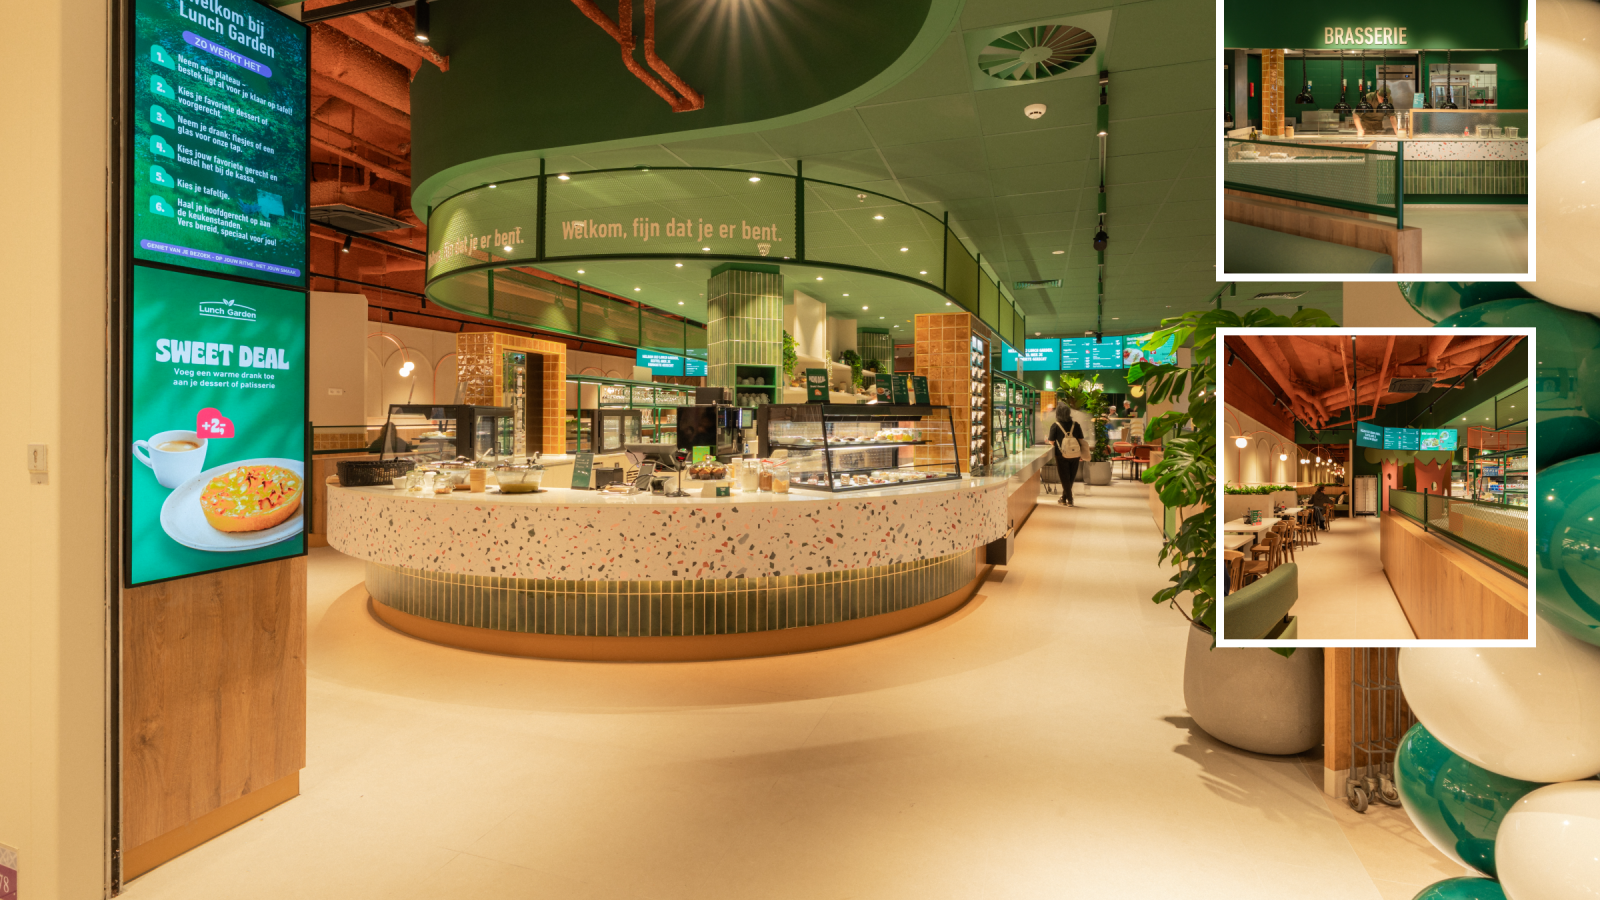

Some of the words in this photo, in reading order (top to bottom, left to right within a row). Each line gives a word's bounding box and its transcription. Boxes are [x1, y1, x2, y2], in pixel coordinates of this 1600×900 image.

[180, 0, 224, 34] Lunch
[228, 24, 274, 58] Garden
[190, 0, 244, 26] elkom
[248, 16, 264, 40] bij
[1324, 26, 1408, 45] BRASSERIE
[156, 52, 164, 63] 1.
[194, 36, 208, 48] ZO
[210, 44, 242, 64] WERKT
[244, 59, 262, 72] HET
[178, 54, 199, 70] Neem
[200, 64, 214, 76] een
[215, 70, 240, 86] plateau
[156, 82, 166, 94] 2.
[178, 64, 202, 80] bestek
[204, 74, 216, 87] ligt
[218, 80, 224, 90] al
[226, 84, 241, 95] voor
[242, 89, 248, 98] je
[250, 92, 266, 106] klaar
[268, 100, 276, 110] op
[156, 112, 165, 123] 3.
[178, 86, 194, 99] Kies
[196, 92, 202, 102] je
[204, 95, 234, 114] favoriete
[236, 108, 260, 124] dessert
[262, 118, 268, 126] of
[178, 97, 222, 118] voorgerecht.
[178, 114, 199, 130] Neem
[200, 122, 207, 132] je
[208, 126, 230, 140] drank:
[232, 134, 254, 148] flesjes
[256, 142, 262, 150] of
[263, 146, 274, 154] een
[178, 126, 194, 136] glas
[195, 131, 210, 142] voor
[212, 137, 228, 148] onze
[230, 142, 242, 154] tap.
[156, 142, 166, 153] 4.
[178, 144, 194, 156] Kies
[194, 148, 212, 162] jouw
[214, 155, 244, 172] favoriete
[244, 166, 268, 179] gerecht
[270, 174, 278, 182] en
[178, 154, 200, 168] bestel
[202, 161, 213, 172] het
[215, 165, 224, 176] bij
[226, 168, 234, 178] de
[236, 172, 256, 184] kassa.
[156, 172, 165, 182] 5.
[178, 178, 192, 190] Kies
[194, 184, 202, 194] je
[204, 186, 230, 200] tafeltje.
[156, 202, 165, 212] 6.
[178, 198, 194, 210] Haal
[195, 203, 202, 212] je
[204, 204, 248, 224] hoofdgerecht
[250, 218, 258, 226] op
[260, 220, 270, 228] aan
[178, 208, 186, 217] de
[188, 210, 242, 230] keukenstanden.
[178, 217, 193, 228] Vers
[195, 220, 220, 235] bereid,
[221, 228, 248, 240] speciaal
[250, 234, 263, 244] voor
[264, 238, 276, 246] jou!
[455, 236, 468, 255] dat
[468, 234, 478, 256] je
[481, 234, 492, 249] er
[494, 228, 524, 247] bent.
[562, 219, 627, 240] Welkom,
[632, 218, 660, 241] fijn
[666, 218, 693, 238] dat
[698, 218, 714, 242] je
[719, 224, 736, 239] er
[742, 220, 782, 242] bent.
[146, 242, 168, 251] GENIET
[190, 250, 211, 260] BEZOEK
[224, 257, 238, 265] JOUW
[199, 304, 224, 315] Lunch
[227, 308, 256, 319] Garden
[156, 338, 234, 366] SWEET
[239, 345, 290, 370] DEAL
[174, 368, 194, 377] Voeg
[241, 370, 262, 379] drank
[190, 378, 198, 388] je
[200, 379, 229, 388] dessert
[240, 381, 276, 389] patisserie
